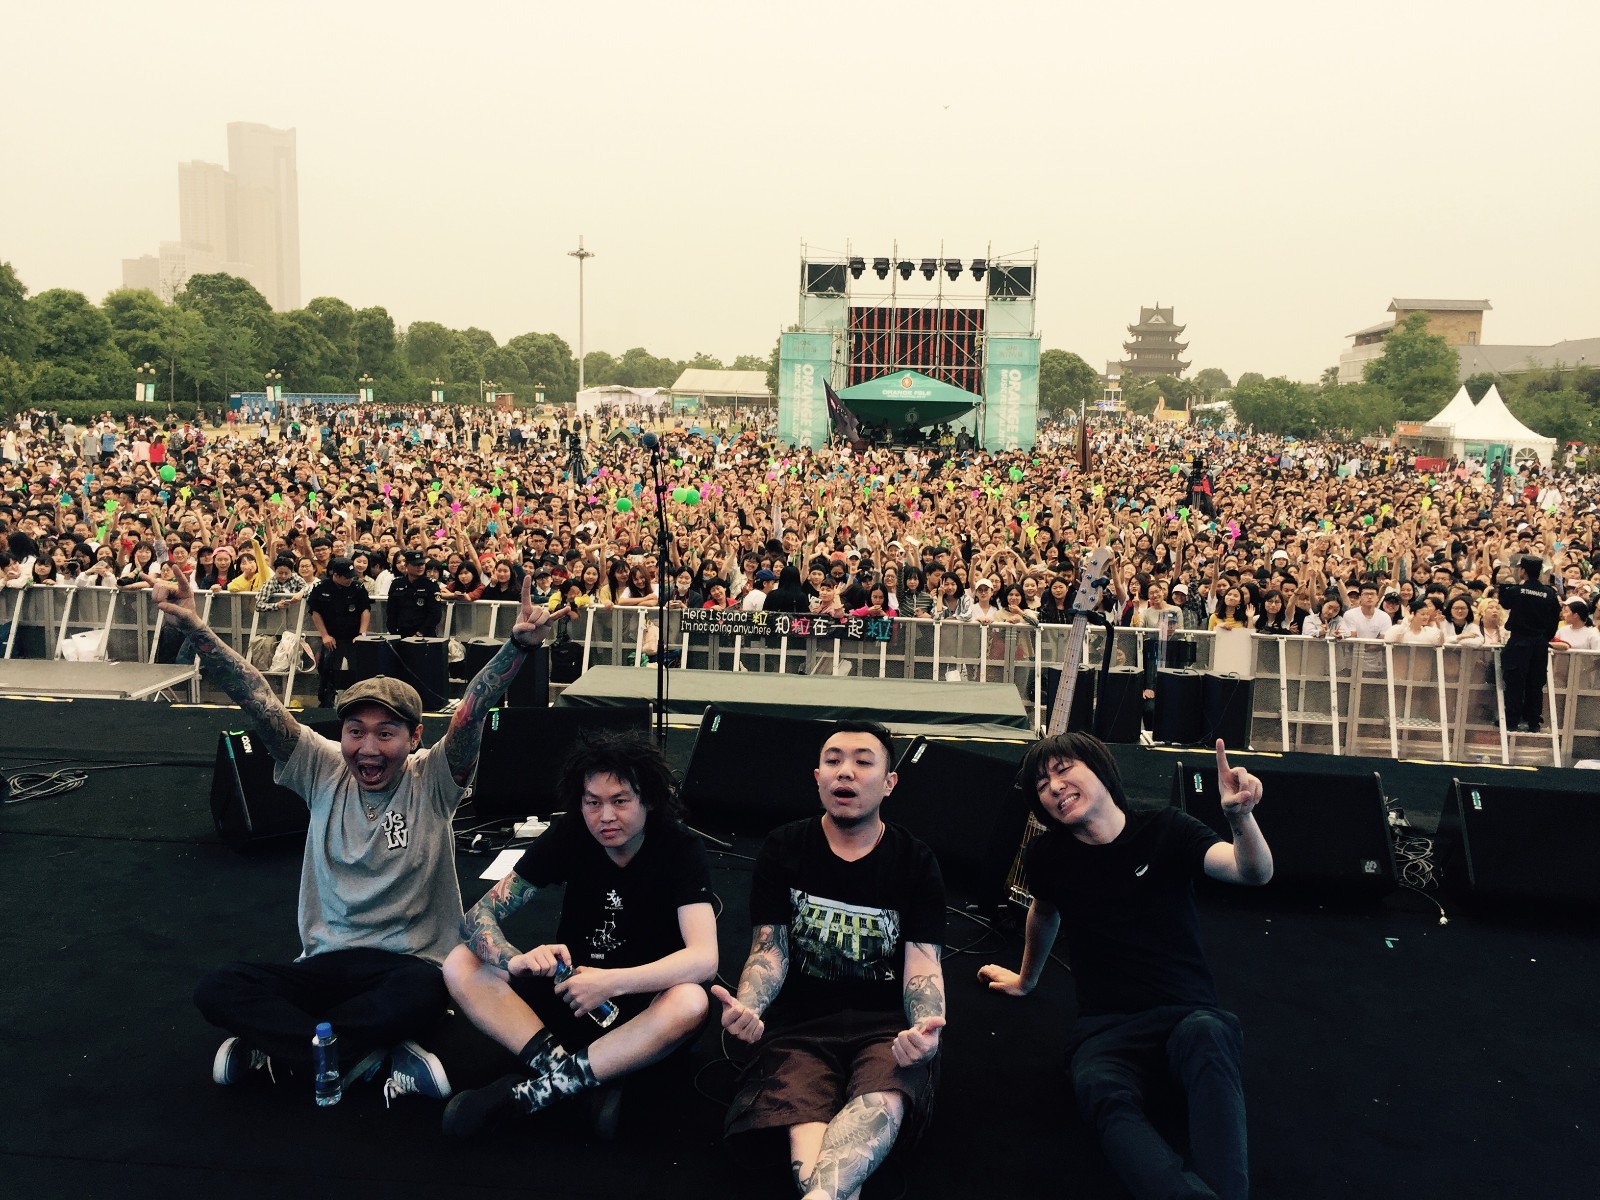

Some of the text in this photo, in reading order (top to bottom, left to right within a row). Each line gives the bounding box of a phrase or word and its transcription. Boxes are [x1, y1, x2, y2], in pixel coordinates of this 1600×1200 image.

[800, 364, 815, 427] ORANGE
[1007, 368, 1022, 433] ORANGE
[680, 620, 772, 636] I'm not going anywhere
[682, 608, 707, 620] Here
[709, 609, 714, 621] I
[716, 611, 748, 622] stand
